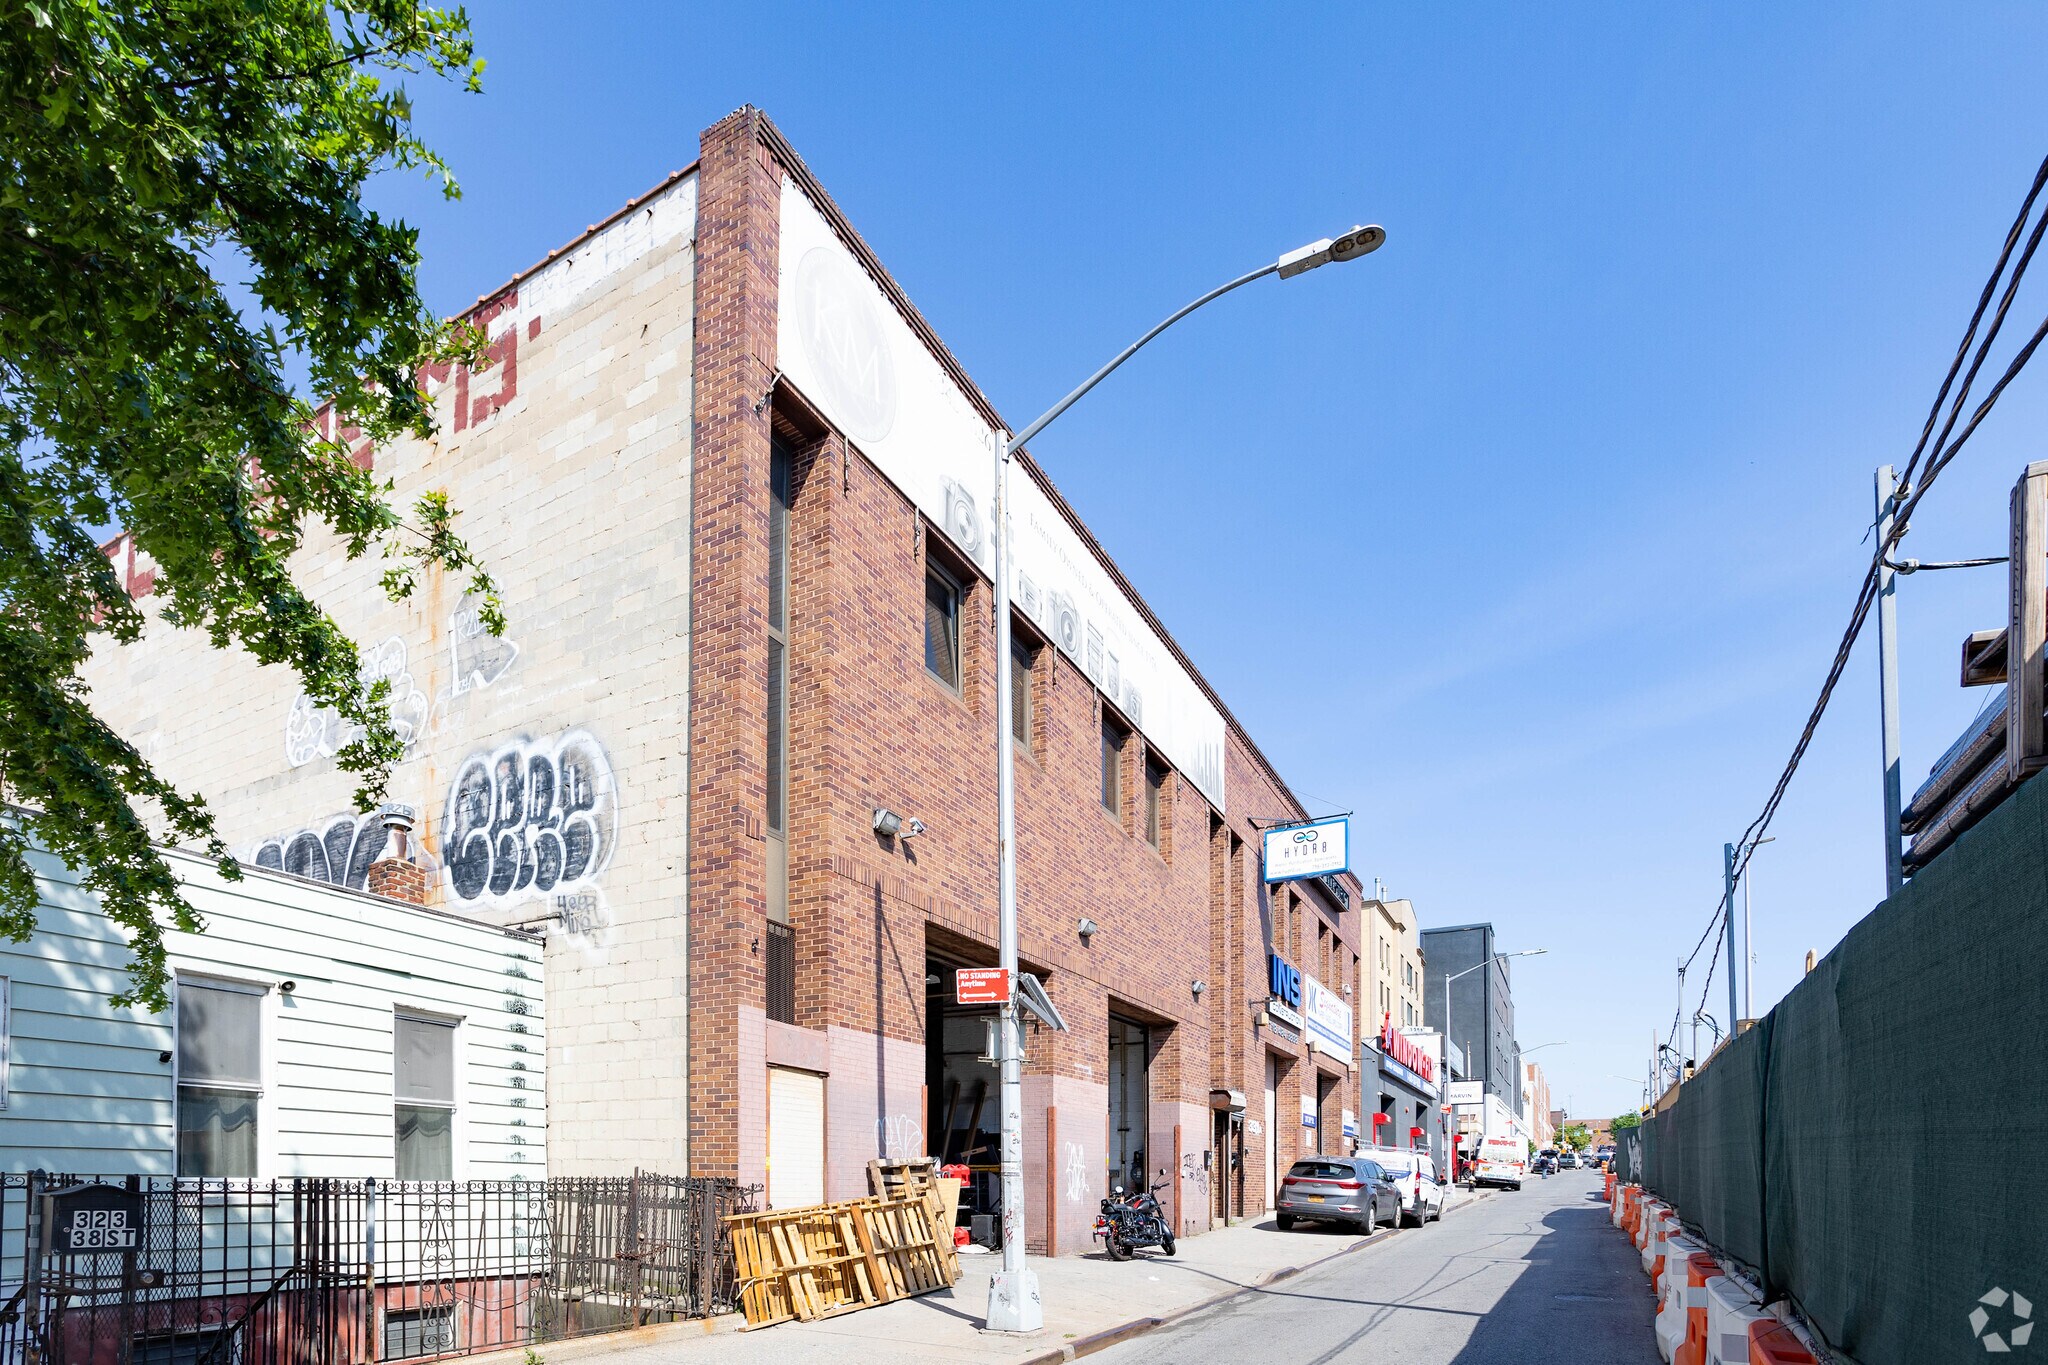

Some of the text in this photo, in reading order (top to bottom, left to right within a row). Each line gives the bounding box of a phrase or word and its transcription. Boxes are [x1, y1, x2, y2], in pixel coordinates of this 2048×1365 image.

[1284, 841, 1328, 859] HYDR8
[1269, 954, 1301, 1007] INS
[76, 1212, 125, 1228] 323
